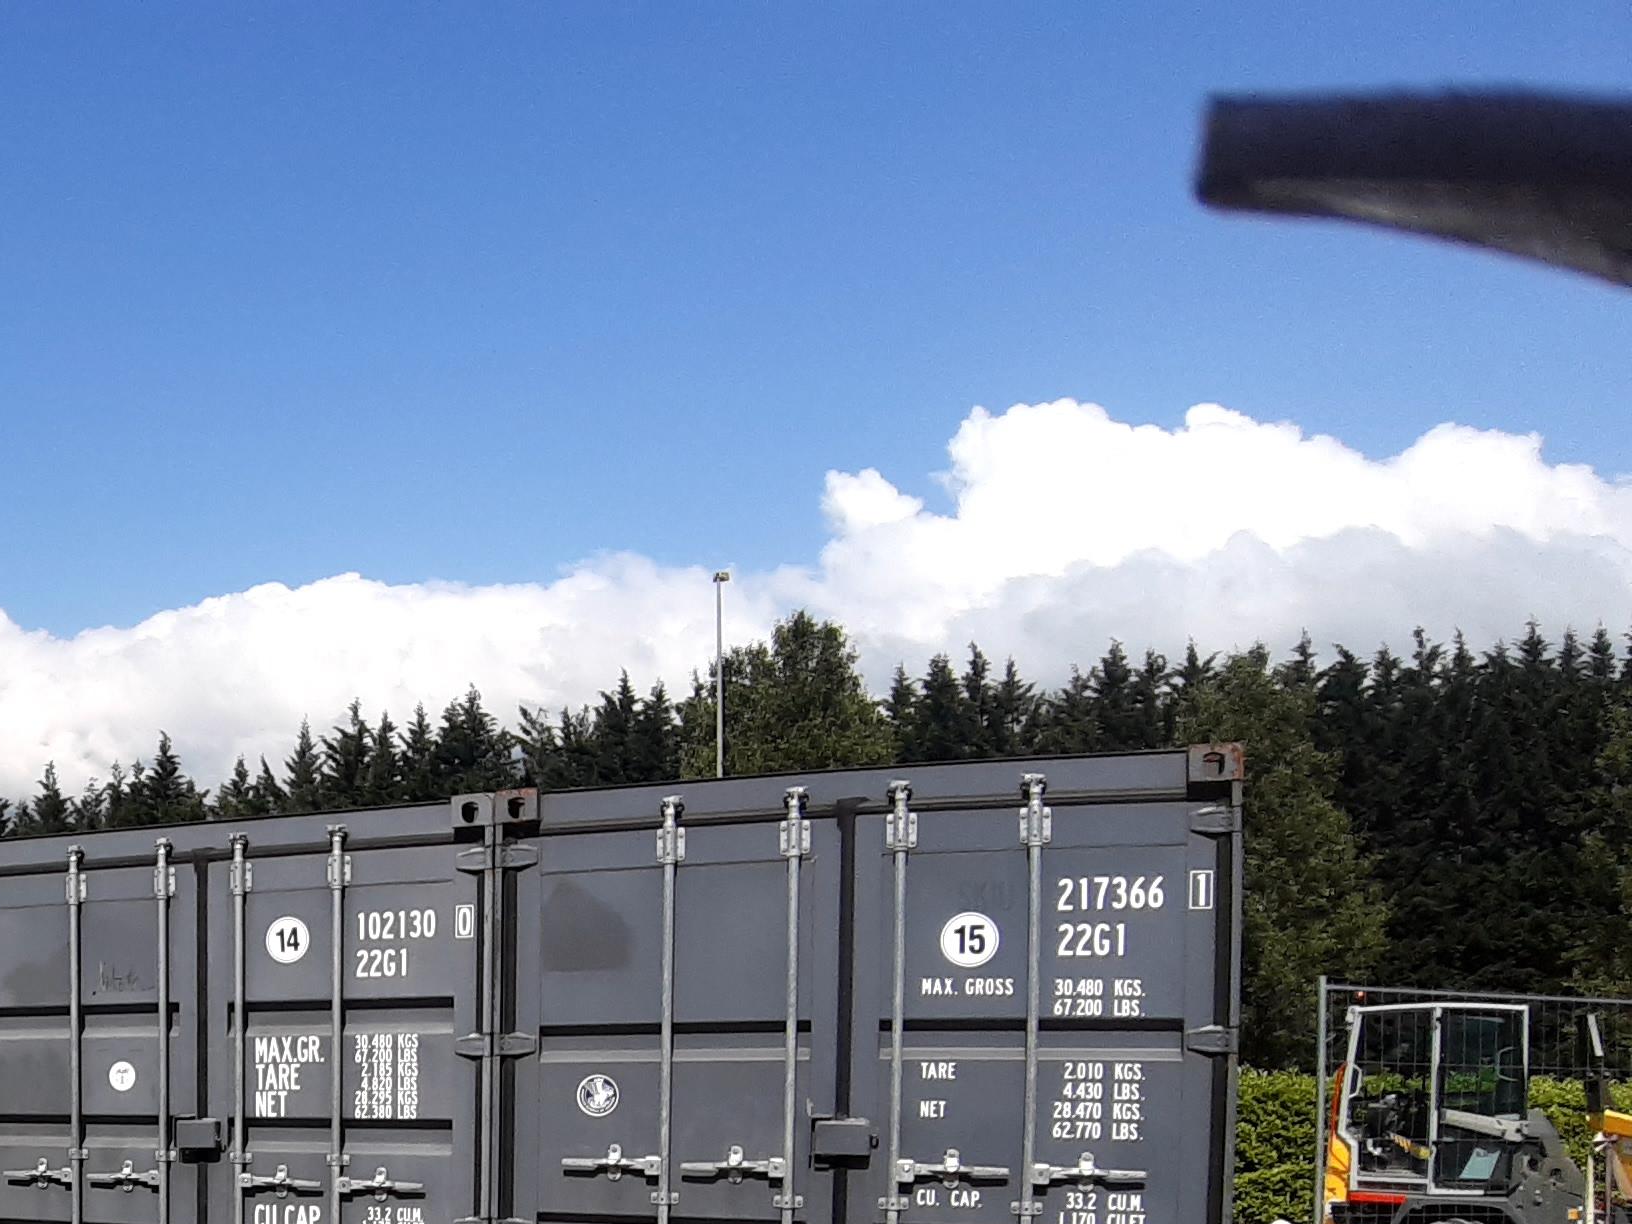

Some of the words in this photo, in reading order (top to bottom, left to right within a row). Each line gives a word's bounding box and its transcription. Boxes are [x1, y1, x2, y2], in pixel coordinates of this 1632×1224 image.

[1057, 876, 1164, 911] 217366
[357, 909, 436, 940] 102130
[276, 927, 300, 952] 14
[953, 925, 986, 955] 15
[1057, 923, 1126, 956] 22G1
[356, 949, 408, 978] 22G1
[921, 978, 958, 995] MAX.
[965, 977, 1014, 996] GROSS
[1054, 979, 1103, 996] 30.480
[1114, 979, 1146, 997] KGS.
[1054, 999, 1102, 1016] 67.200
[1113, 999, 1145, 1017] LBS.
[255, 1035, 325, 1063] MAX.GR.
[355, 1033, 393, 1049] 30.480
[397, 1033, 419, 1049] KGS
[354, 1048, 393, 1063] 67.200
[397, 1048, 418, 1063] LBS
[256, 1063, 301, 1091] TARE
[361, 1062, 393, 1077] 2.185
[397, 1062, 419, 1077] KGS
[920, 1062, 957, 1079] TARE
[1064, 1062, 1103, 1080] 2.010
[1114, 1063, 1146, 1081] KGS.
[361, 1076, 393, 1091] 4.820
[397, 1076, 418, 1091] LBS
[1063, 1082, 1103, 1100] 4.430
[1113, 1083, 1146, 1101] LBS.
[255, 1091, 287, 1118] NET
[354, 1090, 393, 1105] 28.295
[397, 1090, 418, 1105] KGS
[354, 1104, 393, 1119] 62.380
[397, 1104, 418, 1119] LBS
[919, 1100, 946, 1118] NET
[1053, 1101, 1102, 1119] 28.470
[1113, 1103, 1145, 1121] KGS.
[1052, 1121, 1101, 1139] 62.770
[1112, 1122, 1144, 1140] LBS.
[916, 1189, 940, 1206] CU.
[950, 1190, 983, 1208] CAP.
[1066, 1192, 1097, 1210] 33.2
[1108, 1194, 1145, 1212] CU.M.
[367, 1206, 392, 1221] 33.2
